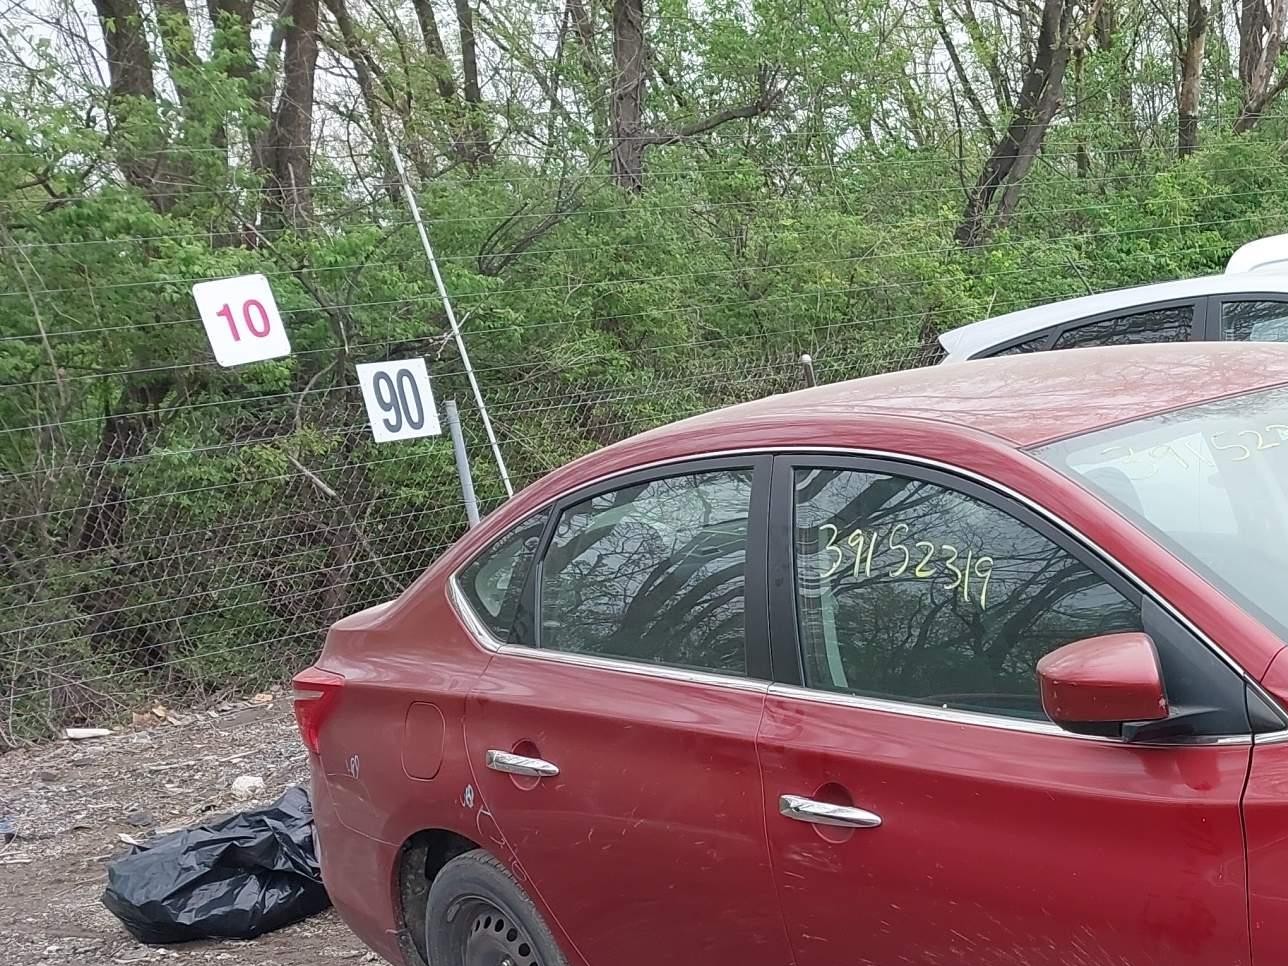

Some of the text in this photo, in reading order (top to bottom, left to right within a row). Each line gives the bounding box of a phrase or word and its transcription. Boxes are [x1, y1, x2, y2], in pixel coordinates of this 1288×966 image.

[216, 299, 271, 342] 10
[372, 368, 425, 433] 90
[819, 523, 994, 611] 39152319
